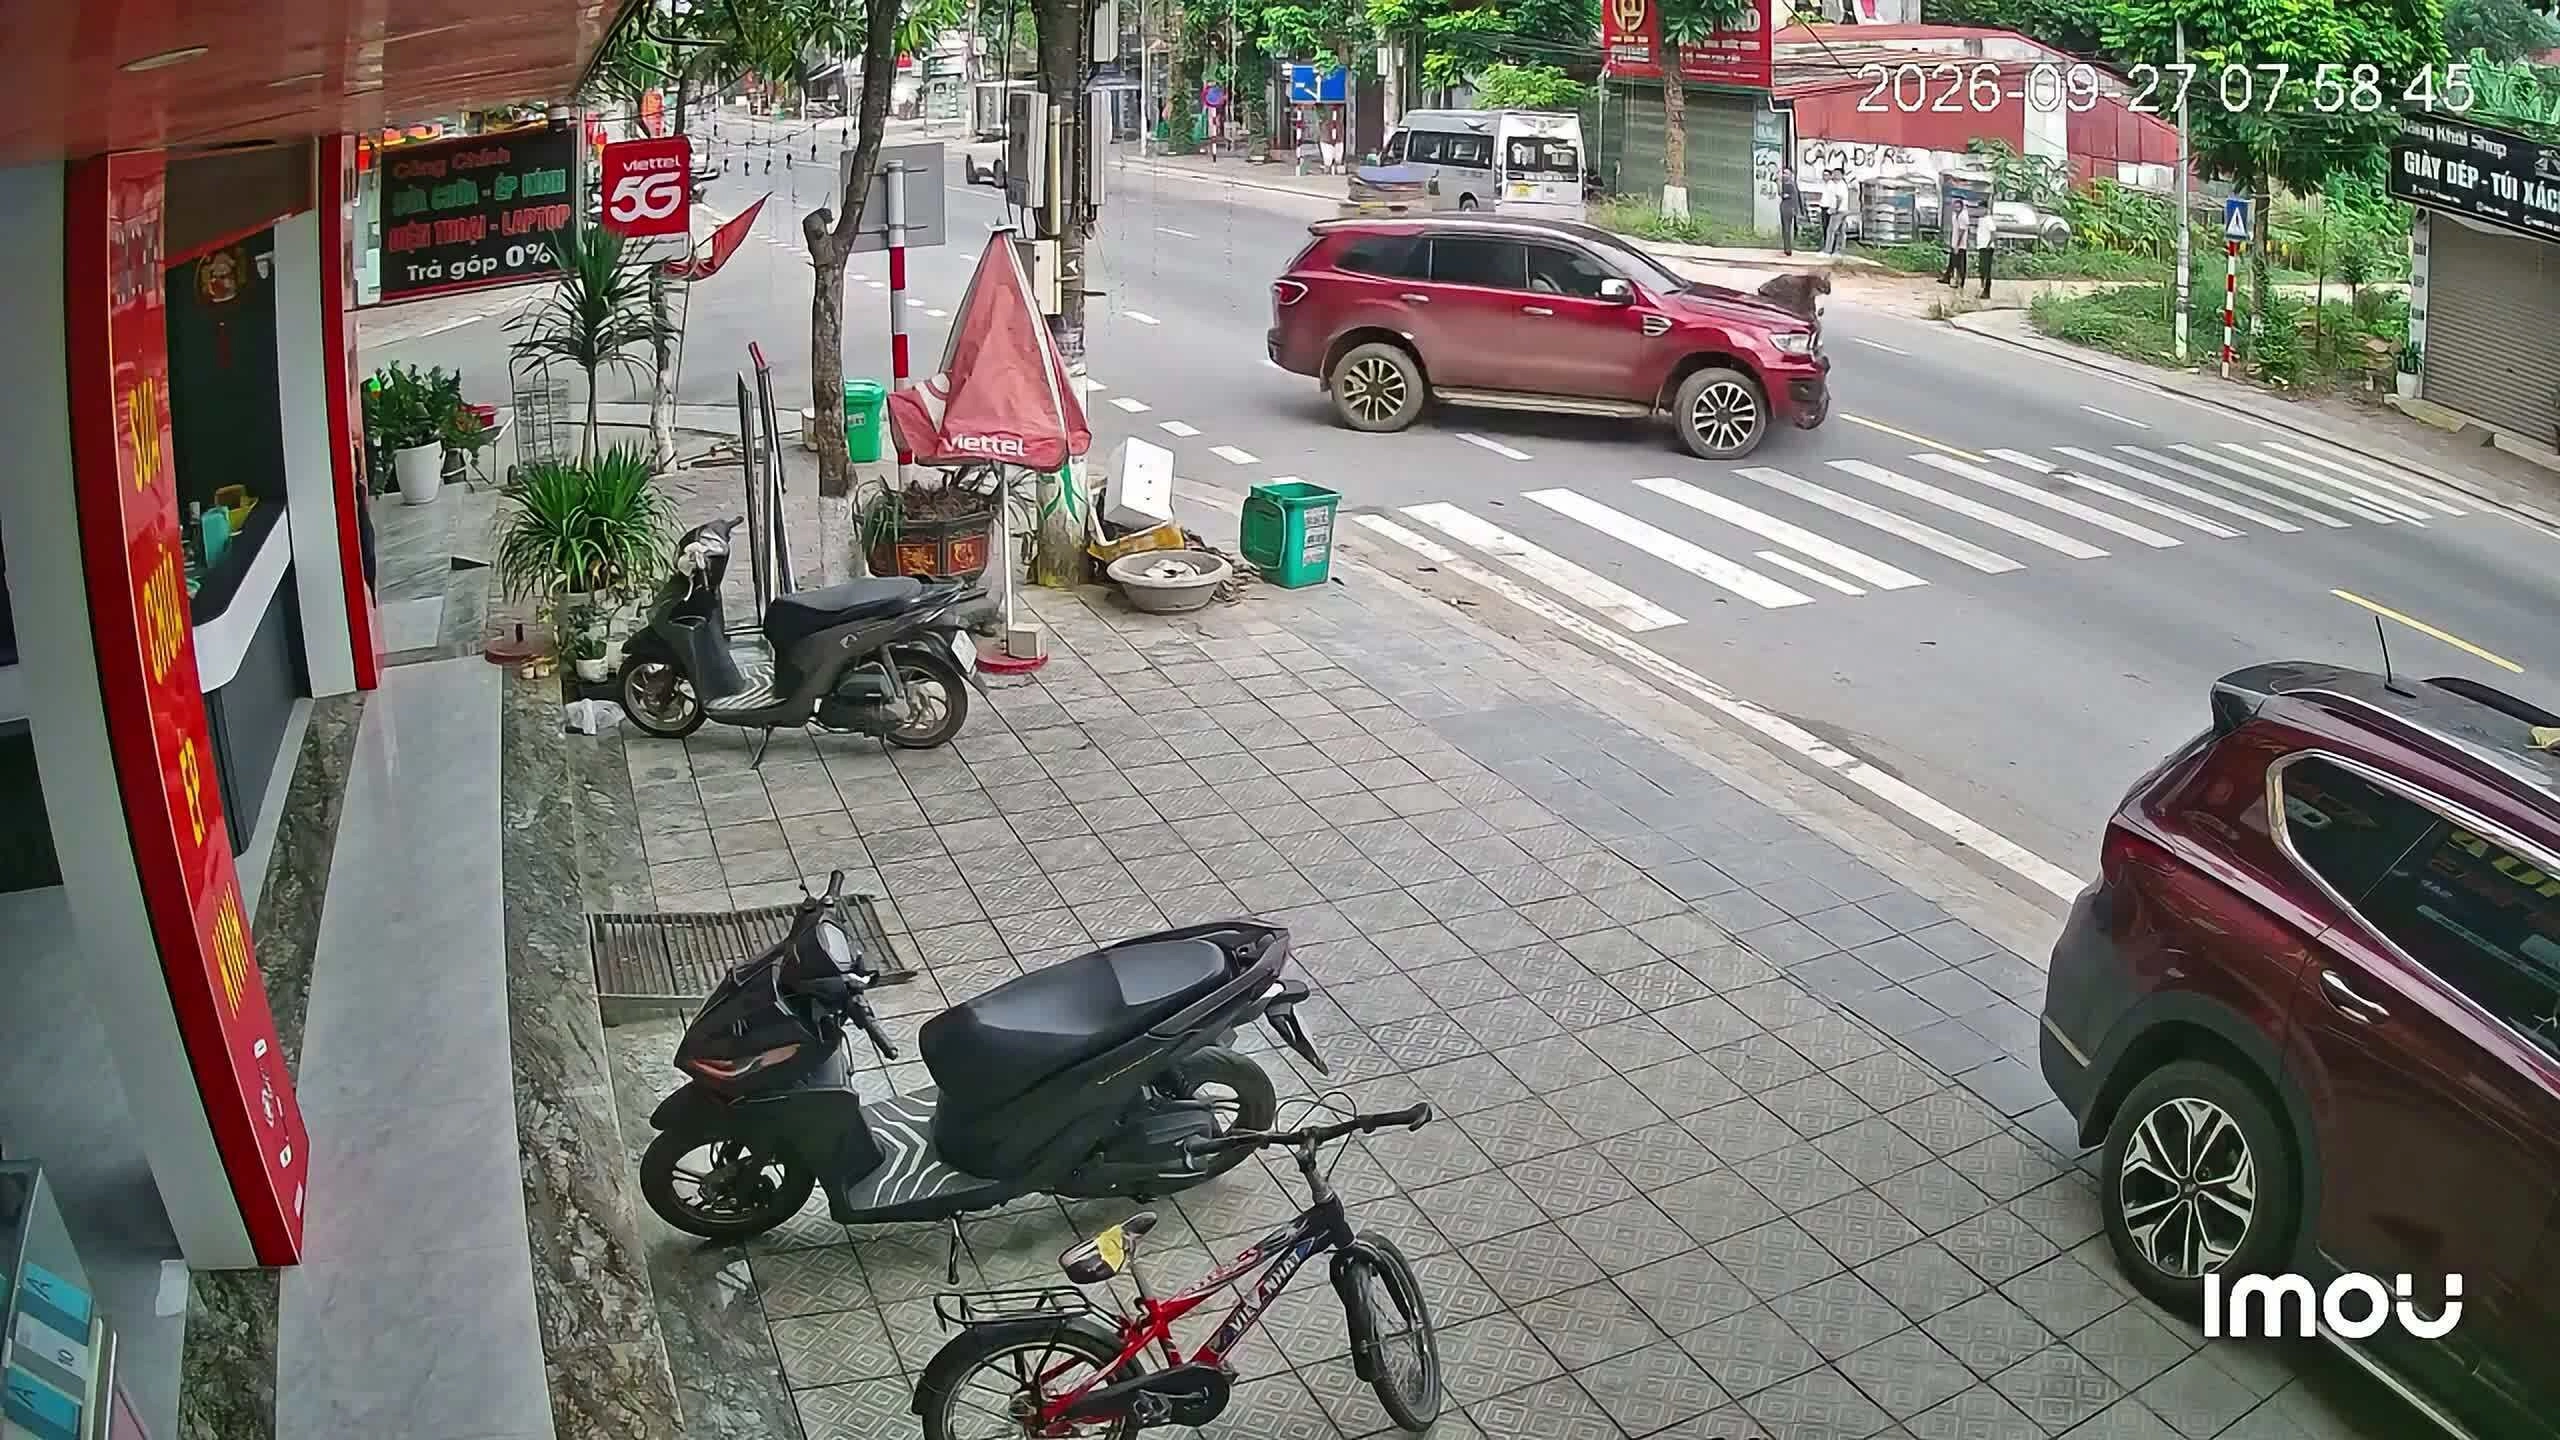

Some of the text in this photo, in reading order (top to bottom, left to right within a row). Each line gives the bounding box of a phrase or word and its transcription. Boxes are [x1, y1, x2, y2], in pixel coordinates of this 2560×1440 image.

[2471, 133, 2508, 160] Shop
[623, 155, 681, 172] viettel
[610, 171, 682, 223] 5G
[2404, 148, 2442, 181] GIÀY
[2446, 159, 2479, 190] DÉP
[2490, 170, 2518, 201] TÚI
[2522, 180, 2560, 214] XÁC
[501, 203, 571, 236] LAPTOP
[406, 241, 551, 281] Trả góp 0%
[939, 432, 1026, 457] viettel
